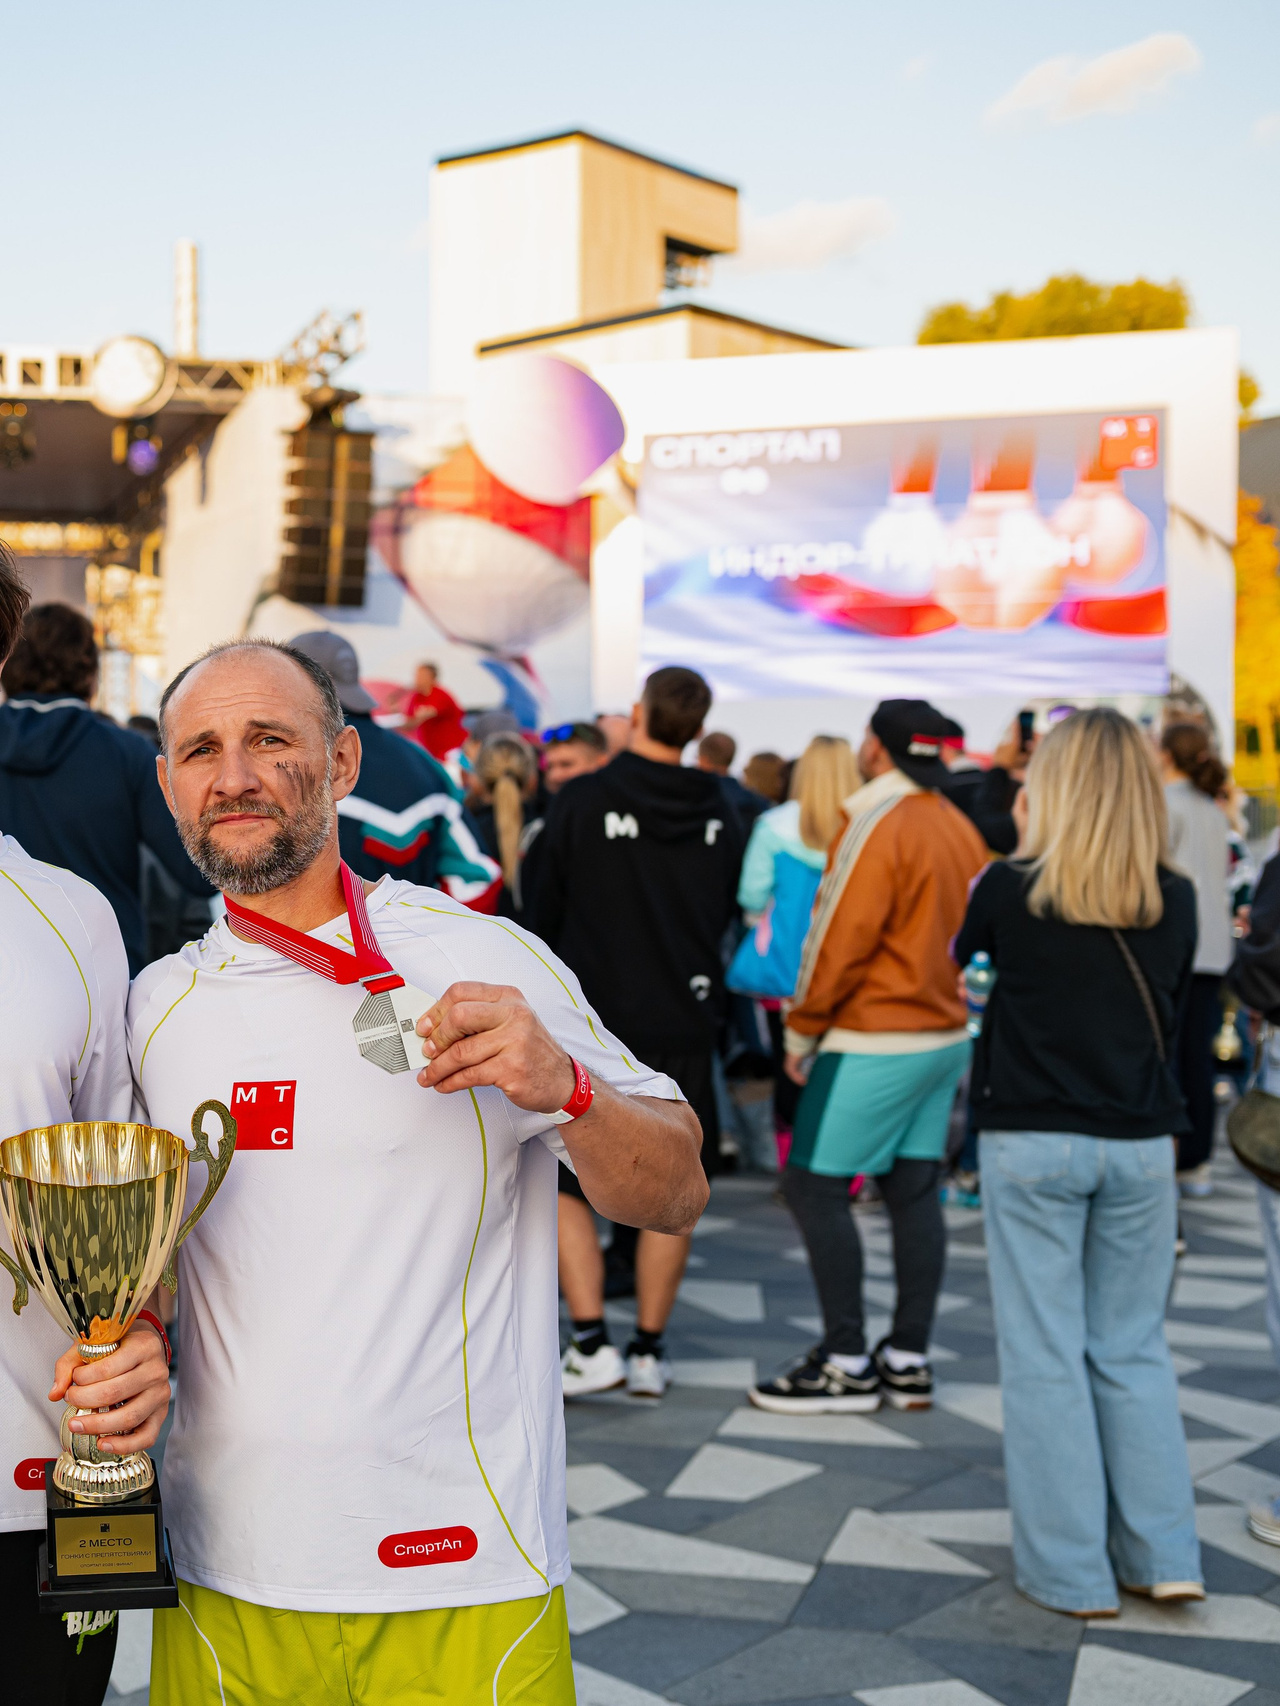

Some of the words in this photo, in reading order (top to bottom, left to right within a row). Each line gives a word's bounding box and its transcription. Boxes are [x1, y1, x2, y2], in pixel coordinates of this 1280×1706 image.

[650, 428, 842, 469] СПОРТАП
[79, 1539, 87, 1548] 2
[89, 1537, 133, 1548] МЕСТО
[394, 1538, 462, 1556] СпортАп
[91, 1550, 152, 1558] ПРЕПЯТСТВИЯМИ
